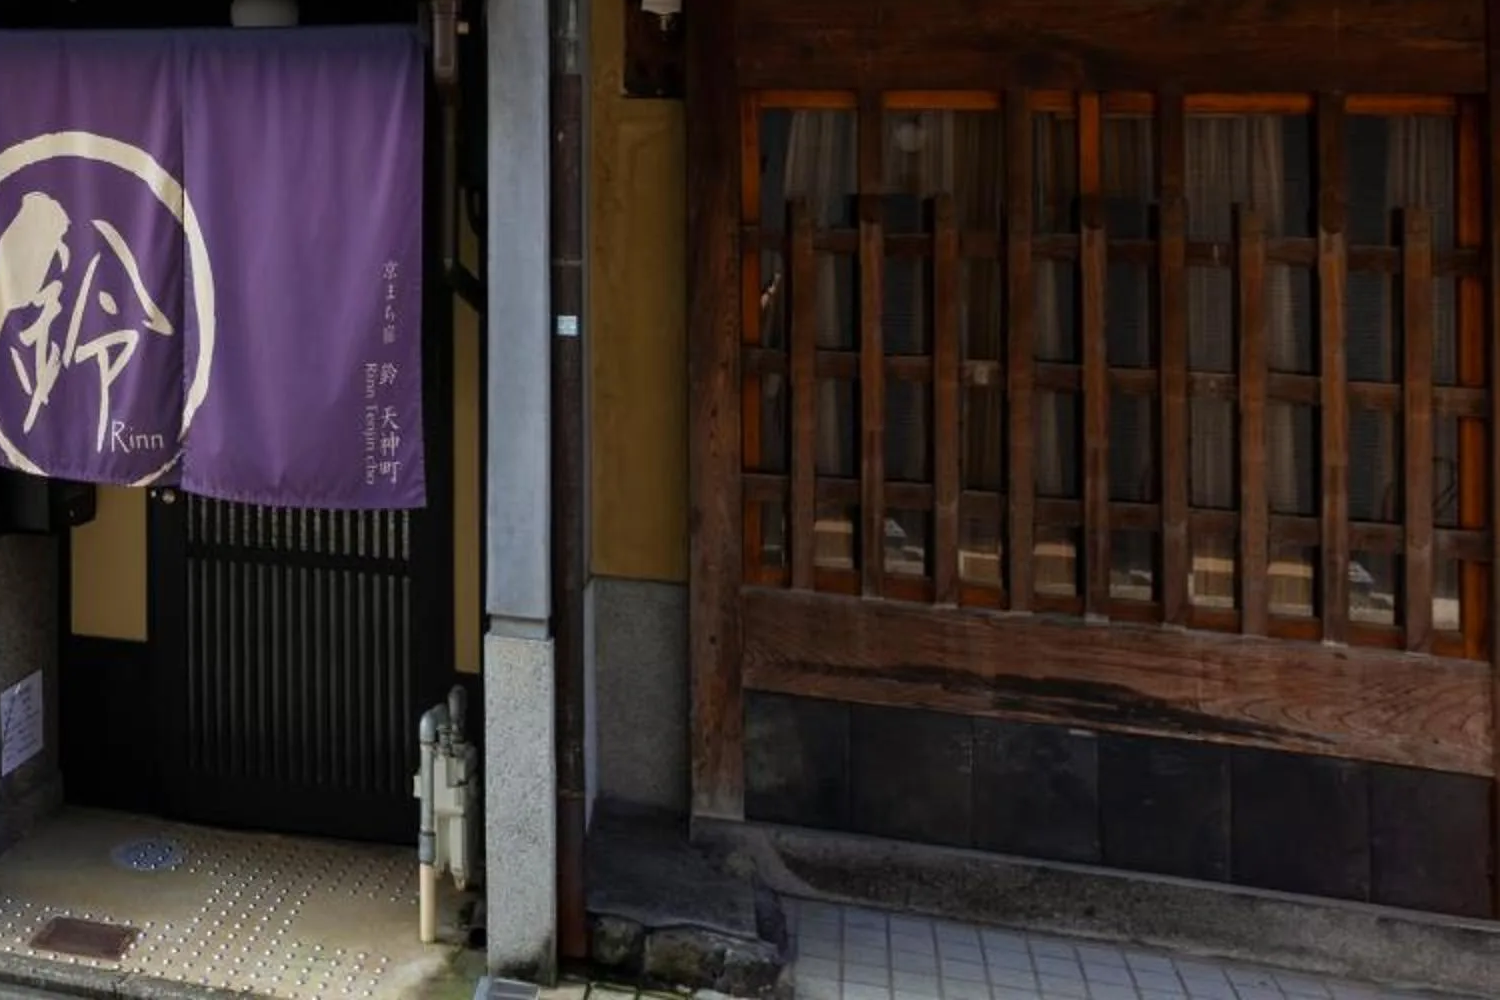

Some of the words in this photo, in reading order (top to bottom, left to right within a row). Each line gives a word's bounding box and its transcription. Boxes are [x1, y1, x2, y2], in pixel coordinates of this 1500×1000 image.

[111, 420, 165, 453] Rinn
[379, 405, 401, 485] 天神町
